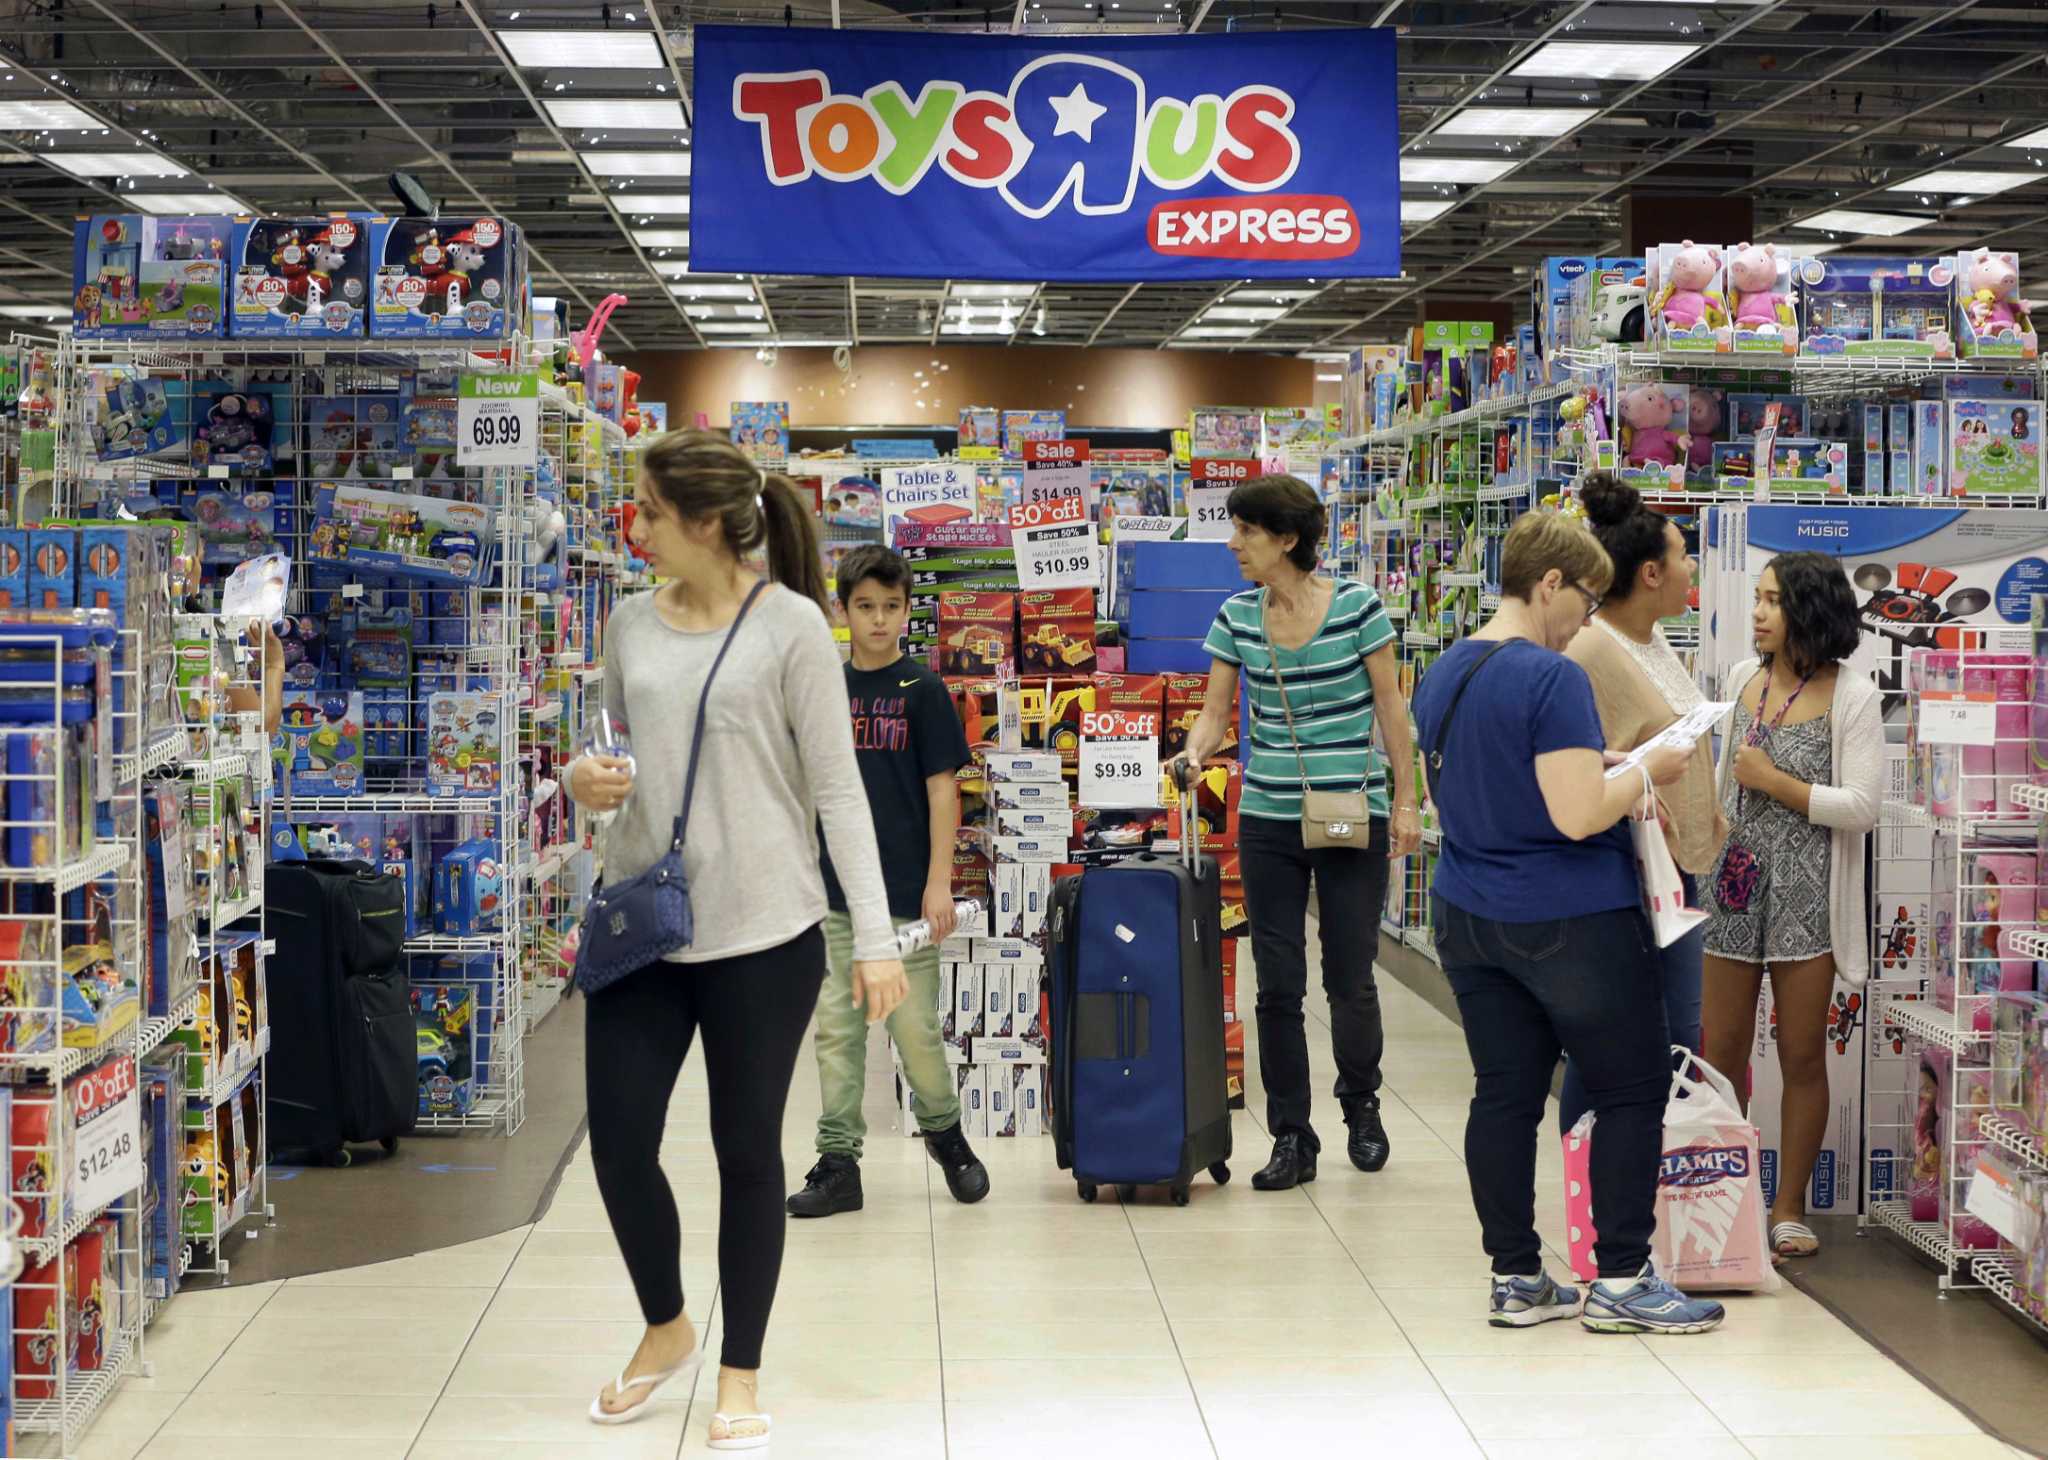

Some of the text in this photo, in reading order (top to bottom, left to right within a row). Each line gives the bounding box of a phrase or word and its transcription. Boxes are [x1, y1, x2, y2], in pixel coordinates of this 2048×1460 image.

[475, 377, 522, 394] New
[473, 415, 521, 446] 69.99
[1035, 443, 1076, 458] Sale
[1036, 460, 1056, 469] Save
[1205, 461, 1248, 478] Sale
[896, 470, 957, 486] Table &
[1206, 479, 1227, 488] Save
[886, 486, 969, 503] Chairs Set
[1010, 498, 1081, 527] 50% off
[1036, 527, 1080, 541] Save 50%
[1798, 526, 1849, 538] MUSIC
[1034, 555, 1090, 577] $10.99
[851, 697, 865, 714] OL
[1082, 713, 1155, 735] 50% off
[850, 716, 909, 752] ELONA
[1094, 762, 1142, 779] $9.98
[75, 1058, 130, 1115] 0% off
[79, 1132, 131, 1182] $12.48
[1660, 1151, 1747, 1177] HAMPS
[1819, 1152, 1831, 1206] MUSIC
[1878, 1152, 1888, 1200] USIC
